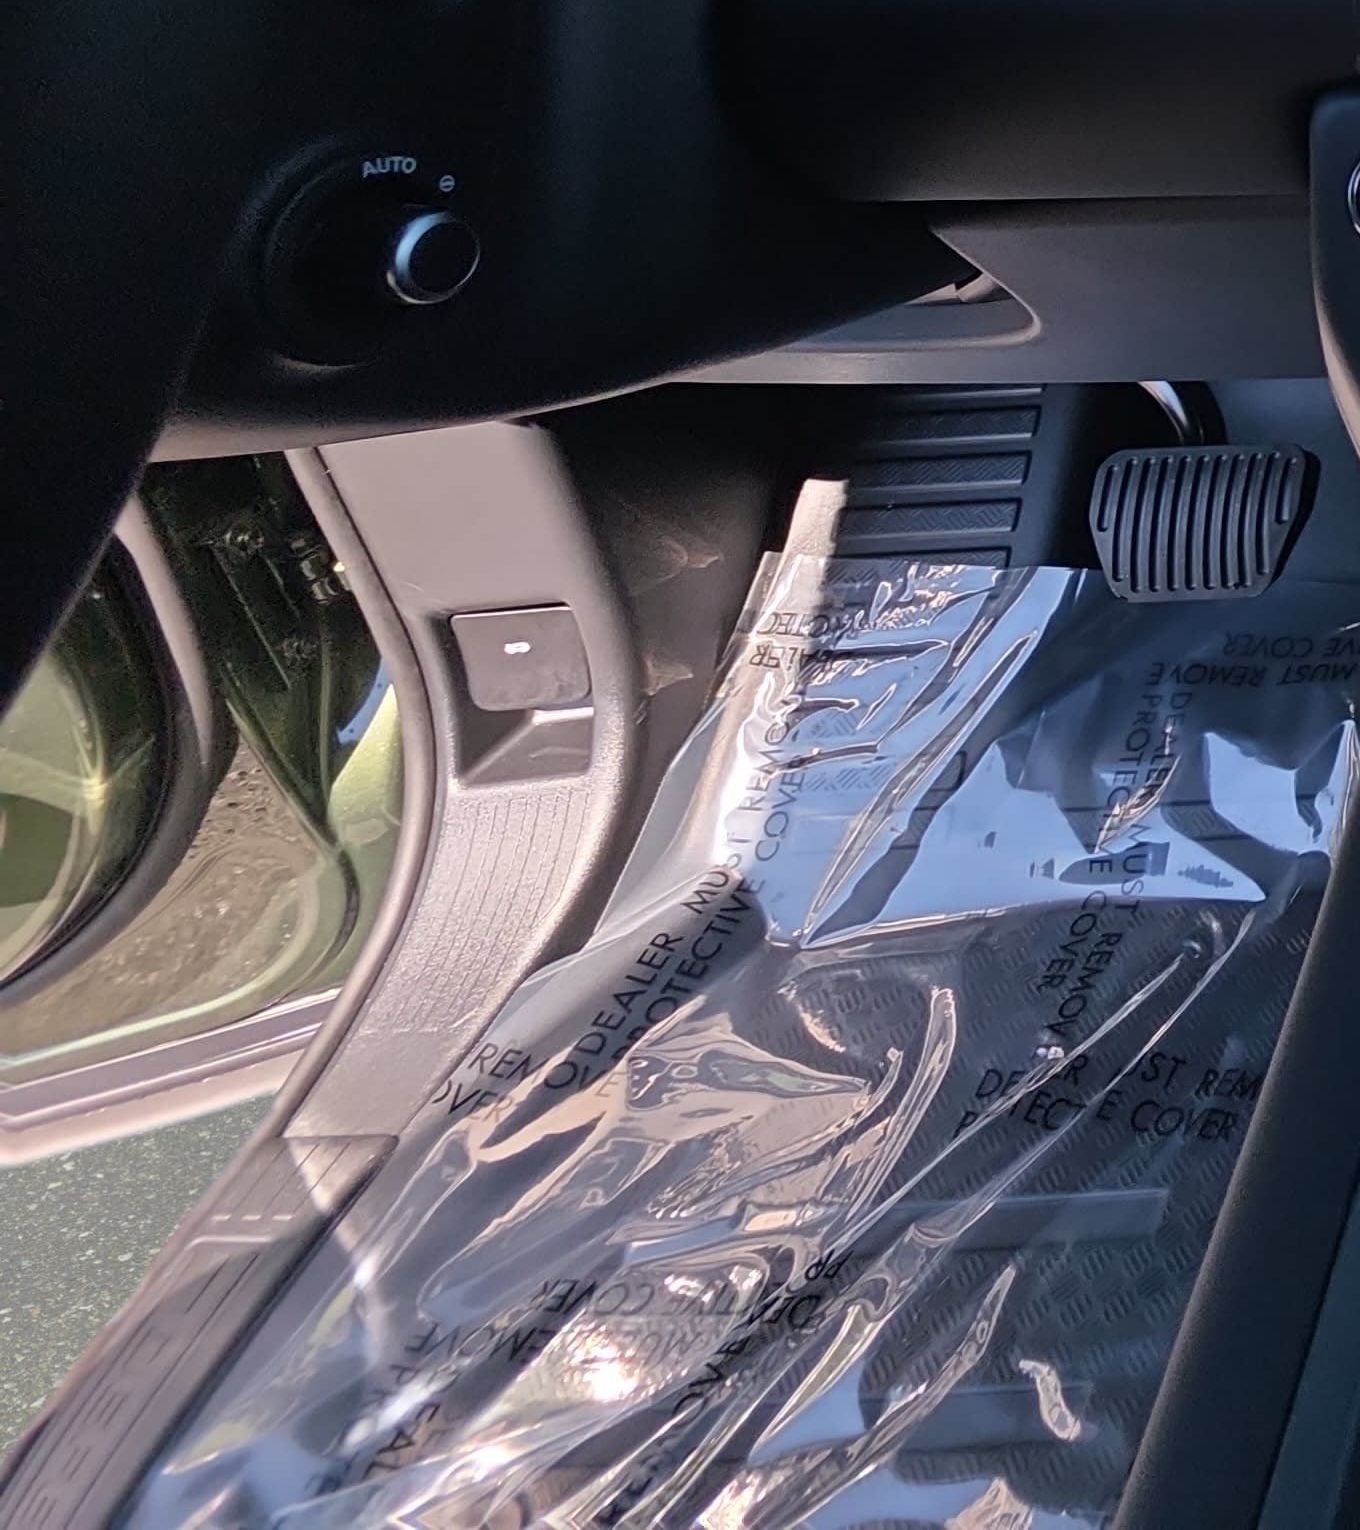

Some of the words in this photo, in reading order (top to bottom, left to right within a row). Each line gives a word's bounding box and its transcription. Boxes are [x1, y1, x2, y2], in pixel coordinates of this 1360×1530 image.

[362, 156, 417, 178] AUTO
[1222, 632, 1314, 657] COVER
[1145, 661, 1263, 687] REMOVE
[1277, 661, 1353, 684] MUST
[754, 757, 808, 863] COVE
[1120, 823, 1153, 919] MUST
[1034, 891, 1113, 991] COVER
[578, 932, 684, 1062] DEALER
[1043, 933, 1126, 1043] REMOV
[1194, 1071, 1261, 1102] REM
[953, 1090, 1118, 1140] PTECTE
[1130, 1099, 1239, 1141] COVER
